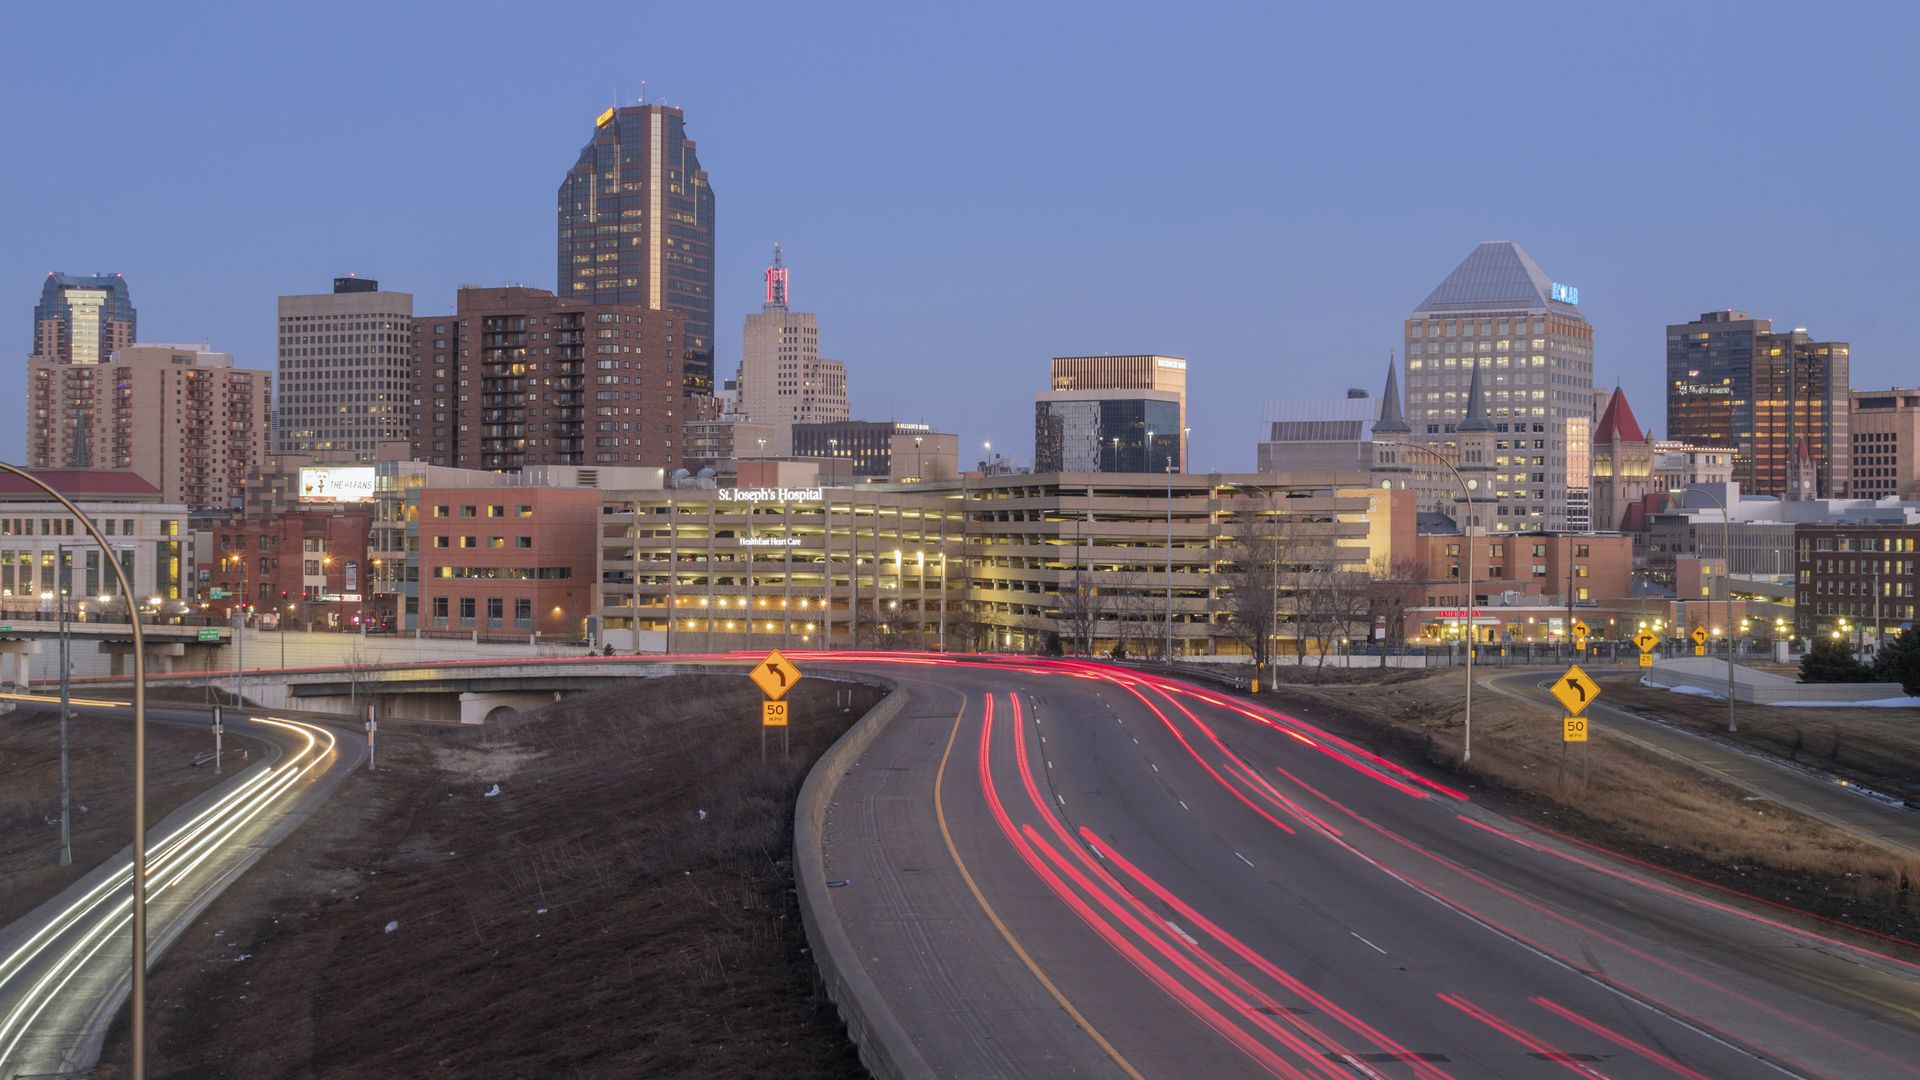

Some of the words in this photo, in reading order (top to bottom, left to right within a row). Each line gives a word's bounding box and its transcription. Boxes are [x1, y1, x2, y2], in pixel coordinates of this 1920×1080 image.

[330, 481, 343, 489] THE
[354, 482, 372, 490] FANS
[719, 488, 731, 501] St.
[734, 488, 776, 503] Joseph's
[778, 488, 822, 503] Hospital
[740, 538, 770, 546] HealthEast
[771, 538, 787, 546] Heart
[787, 538, 801, 546] Care
[767, 704, 784, 715] 50
[1567, 721, 1584, 732] 50
